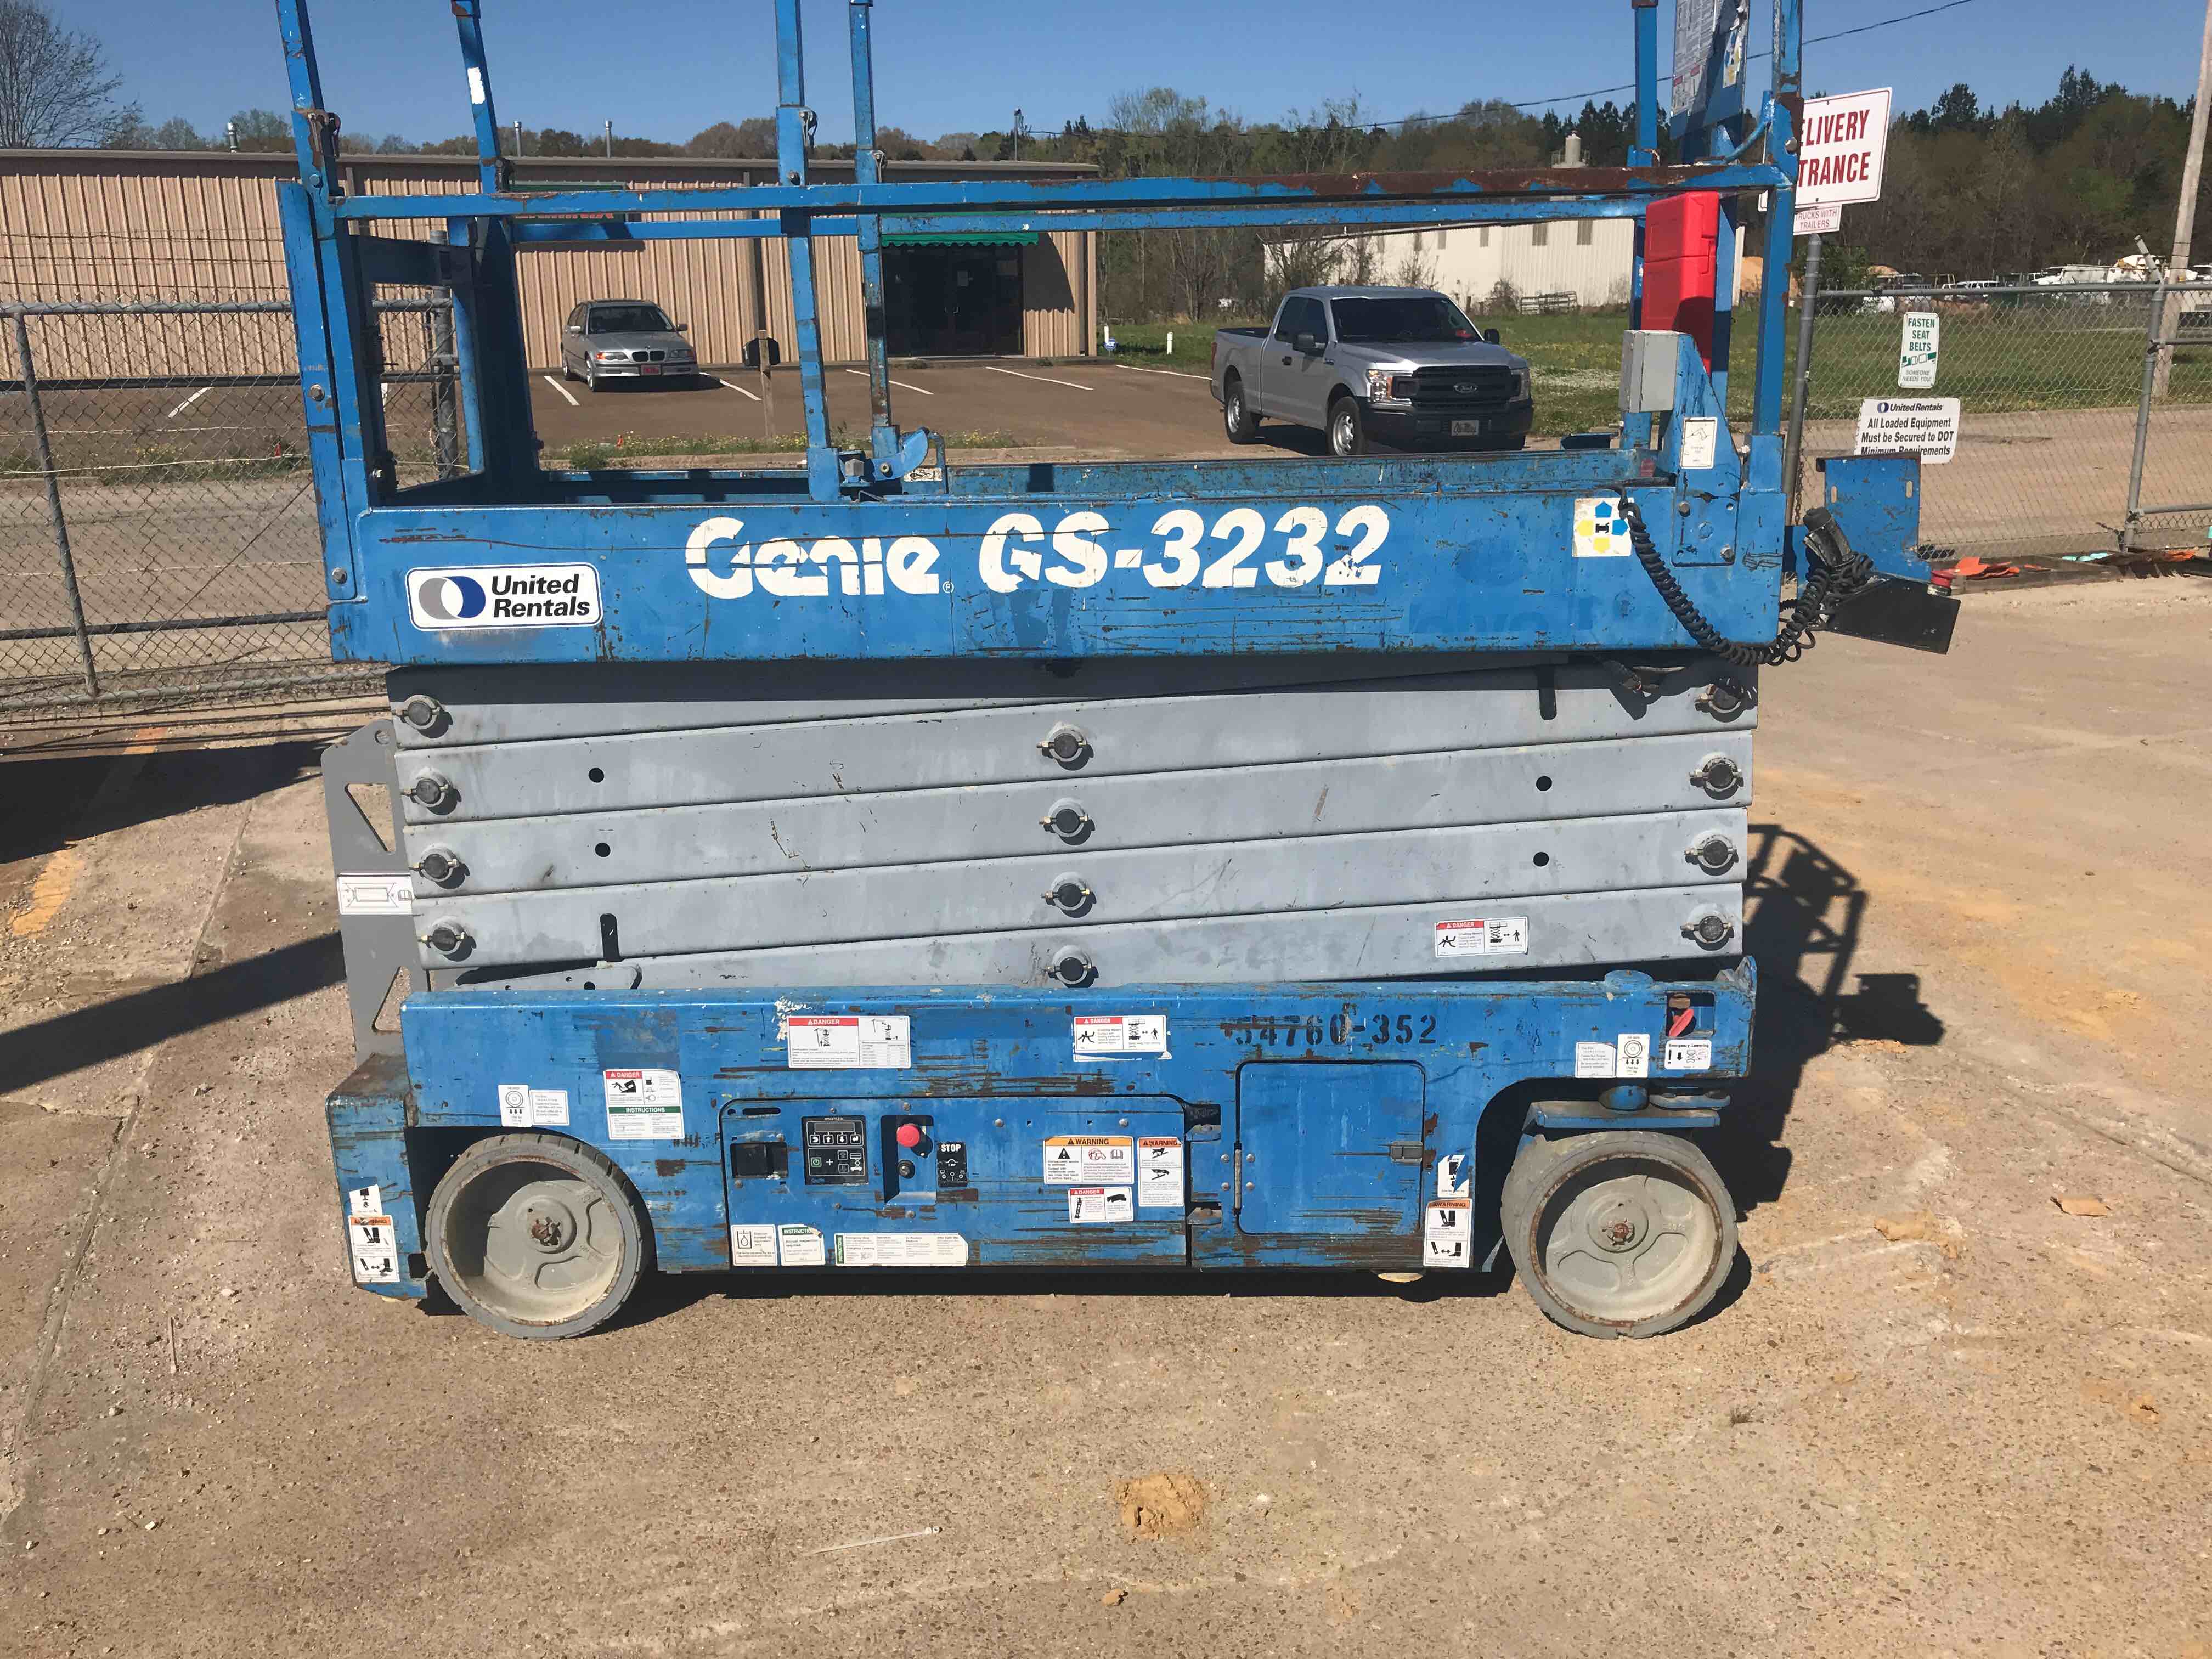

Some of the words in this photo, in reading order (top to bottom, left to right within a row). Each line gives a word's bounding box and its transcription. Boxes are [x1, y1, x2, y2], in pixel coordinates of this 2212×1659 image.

[1800, 109, 1870, 146] LIVERY
[1798, 151, 1871, 187] TRANCE
[1800, 219, 1830, 229] TRAILERS
[1908, 318, 1935, 328] FASTEN
[1912, 330, 1930, 339] SEAT
[1909, 342, 1931, 352] BELTS
[1889, 403, 1915, 411] United
[1915, 403, 1943, 411] Rentals
[1867, 418, 1878, 428] All
[1880, 418, 1909, 428] Loaded
[1910, 417, 1951, 430] Equipment
[1861, 433, 1882, 443] Must
[1883, 433, 1892, 442] be
[1894, 432, 1925, 442] Secured
[1927, 432, 1935, 442] to
[1937, 431, 1954, 441] DOT
[685, 517, 940, 599] Genie
[979, 505, 1390, 593] GS-3232
[492, 573, 580, 596] United
[493, 596, 590, 618] Rentals
[941, 1144, 961, 1152] STOP
